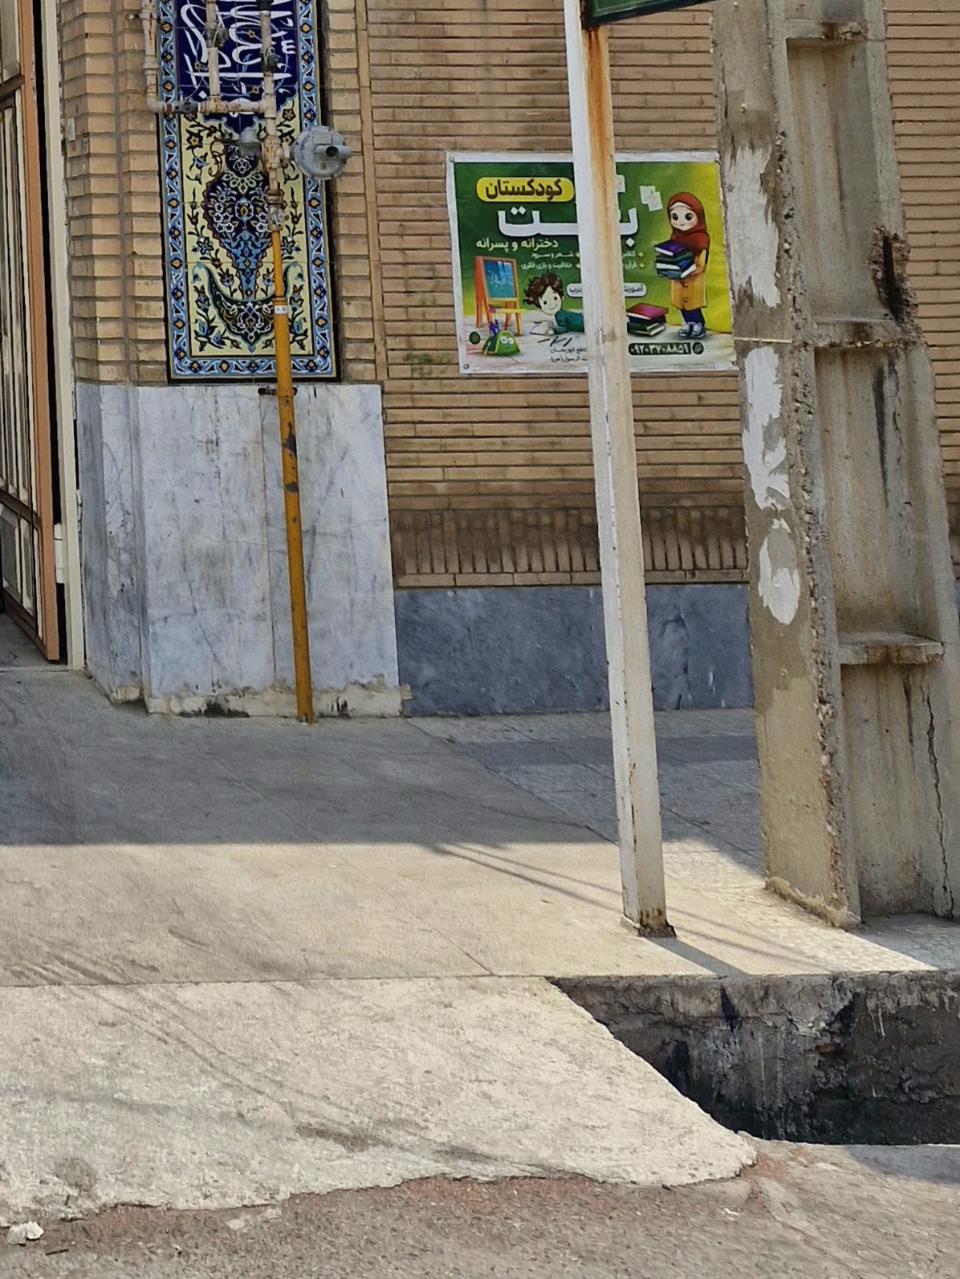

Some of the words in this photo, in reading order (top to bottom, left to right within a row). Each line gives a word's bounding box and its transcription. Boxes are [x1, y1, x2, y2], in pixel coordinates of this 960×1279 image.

[485, 178, 563, 201] کودکستان
[475, 238, 509, 253] پسرانه
[511, 241, 519, 250] و
[520, 238, 559, 252] دخترانه
